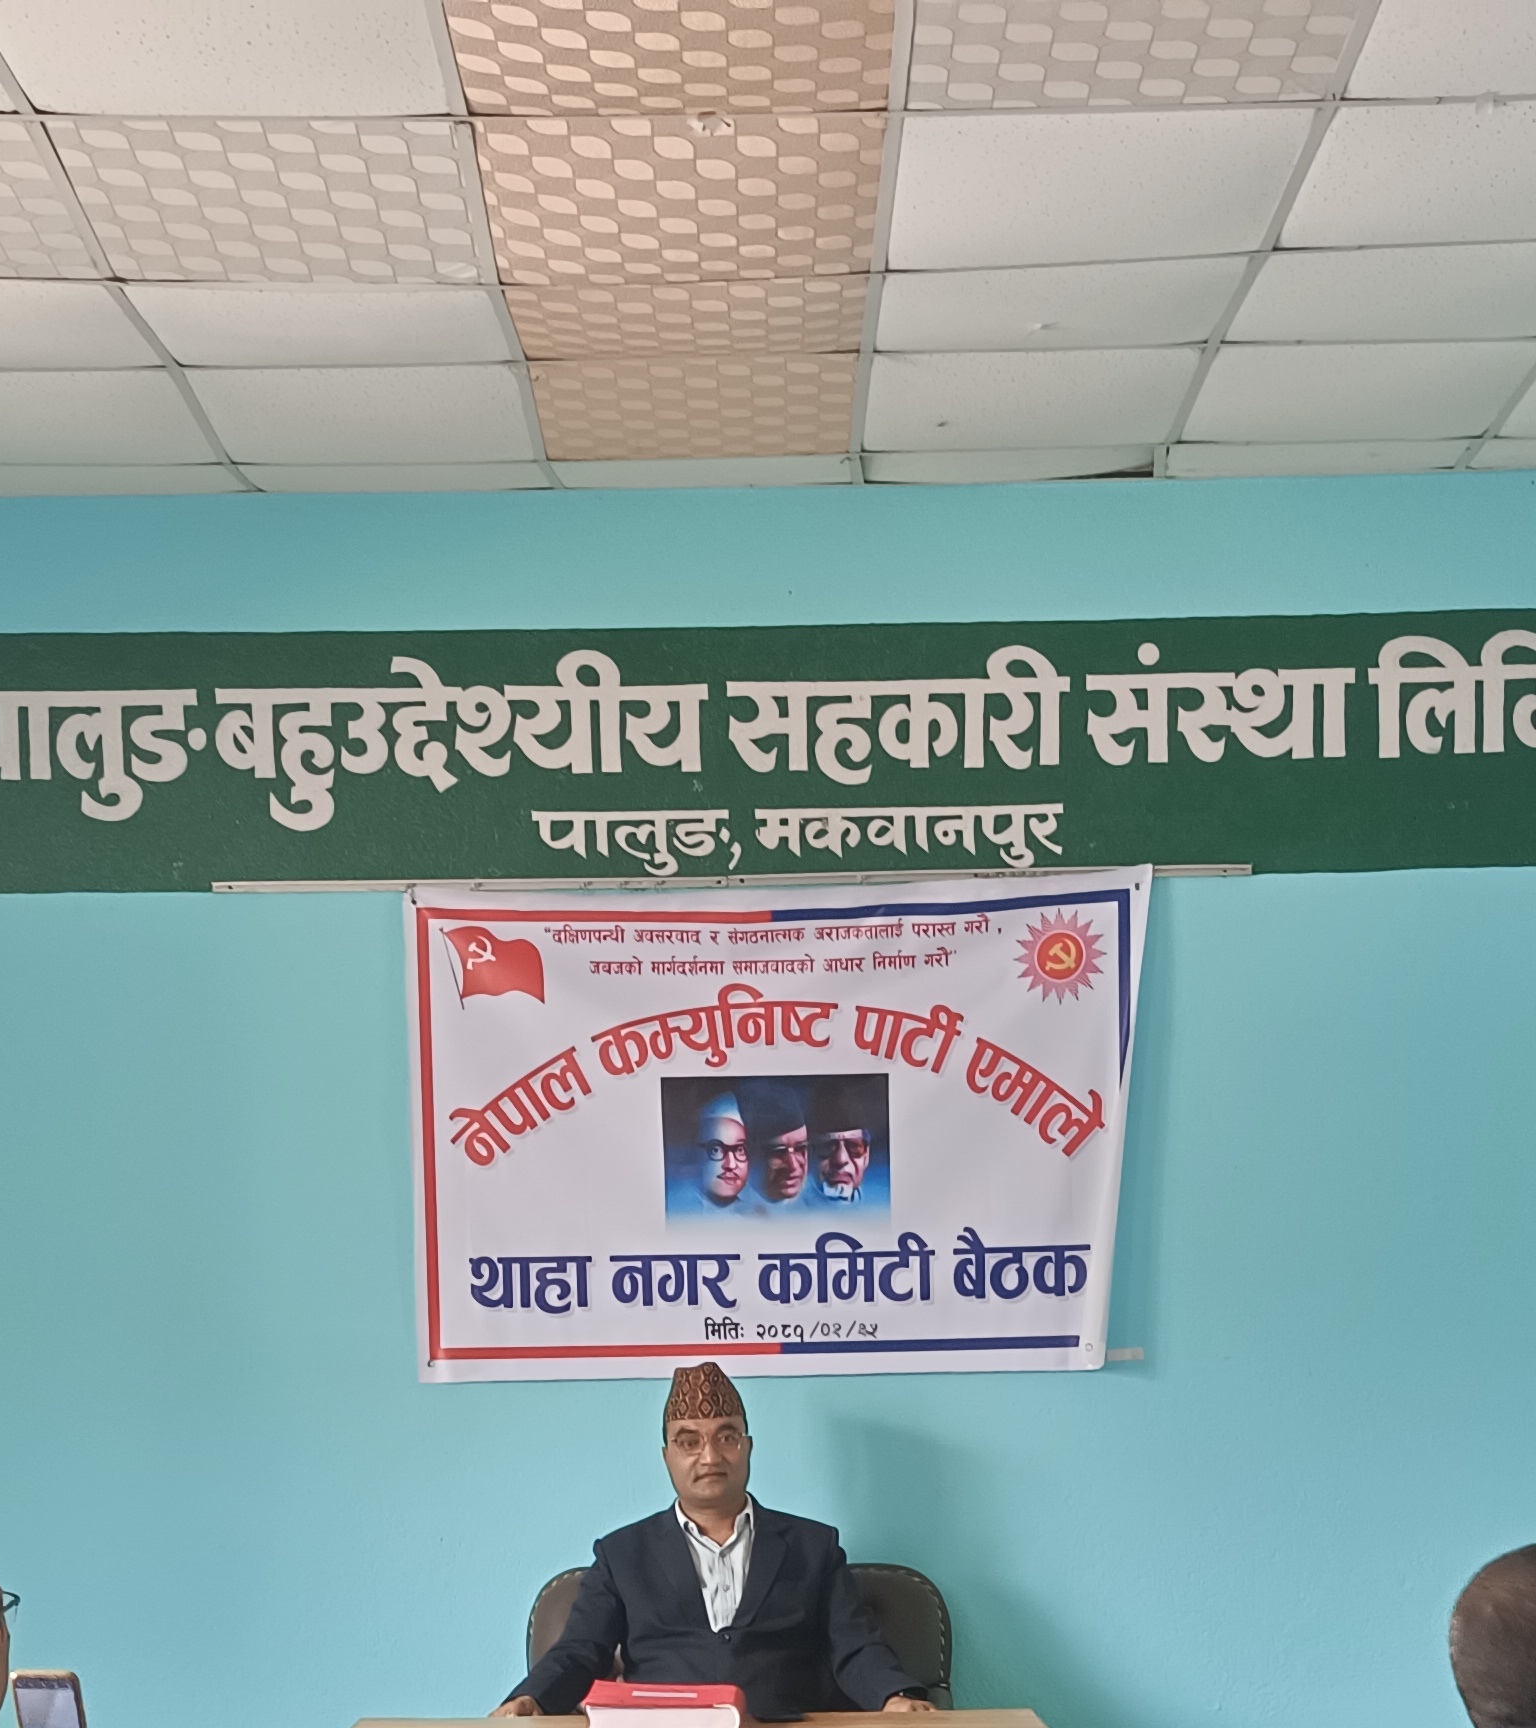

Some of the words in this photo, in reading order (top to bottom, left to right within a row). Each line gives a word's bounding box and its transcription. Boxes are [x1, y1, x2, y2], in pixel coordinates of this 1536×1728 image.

[727, 645, 1071, 785] सहकारी
[1086, 642, 1355, 769] संस्था
[755, 803, 1064, 868] मकवानपुर
[709, 930, 721, 946] र
[912, 921, 957, 938] परास्त
[732, 953, 815, 976] समाजवादको
[824, 957, 865, 973] आधार
[872, 950, 916, 971] निर्माण
[449, 1045, 593, 1167] नेपाल
[591, 983, 839, 1067] कम्युनिष्ट
[854, 1004, 965, 1074] पार्टी
[966, 1036, 1106, 1157] एमाले
[468, 1255, 593, 1315] थाहा
[609, 1253, 741, 1309] नगर
[757, 1231, 936, 1304] कमिटी
[952, 1226, 1091, 1299] बैठक
